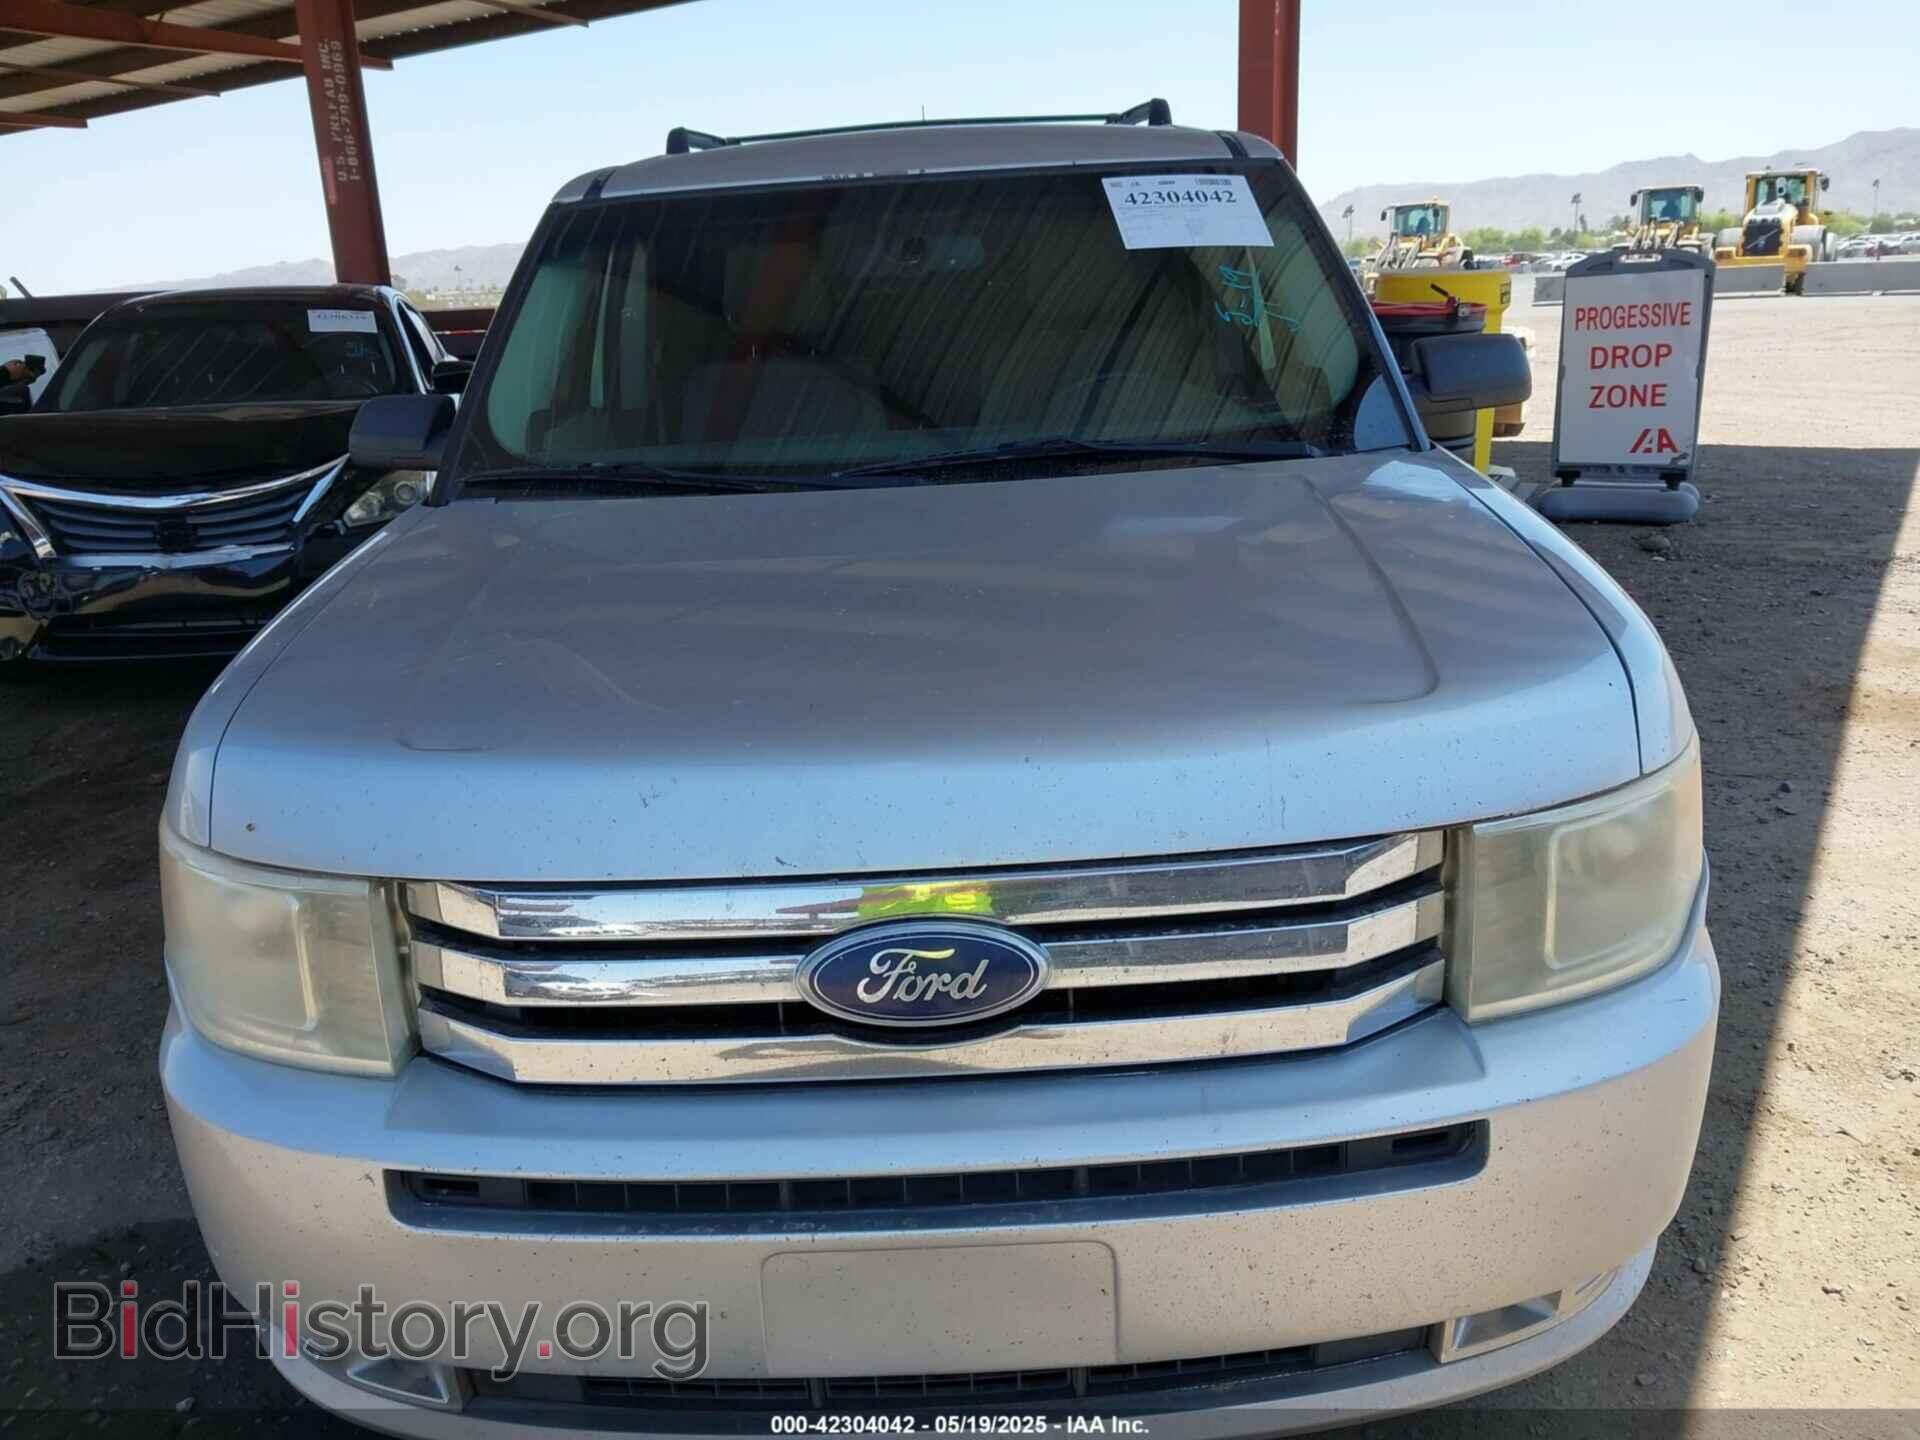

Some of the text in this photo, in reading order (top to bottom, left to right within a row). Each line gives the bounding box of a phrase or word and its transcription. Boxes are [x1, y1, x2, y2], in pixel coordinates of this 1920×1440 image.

[1124, 189, 1237, 205] 42304042
[1575, 302, 1692, 331] PROGESSIVE
[1589, 343, 1673, 369] DROP
[1588, 383, 1667, 408] ZONE
[857, 948, 989, 1003] Ford
